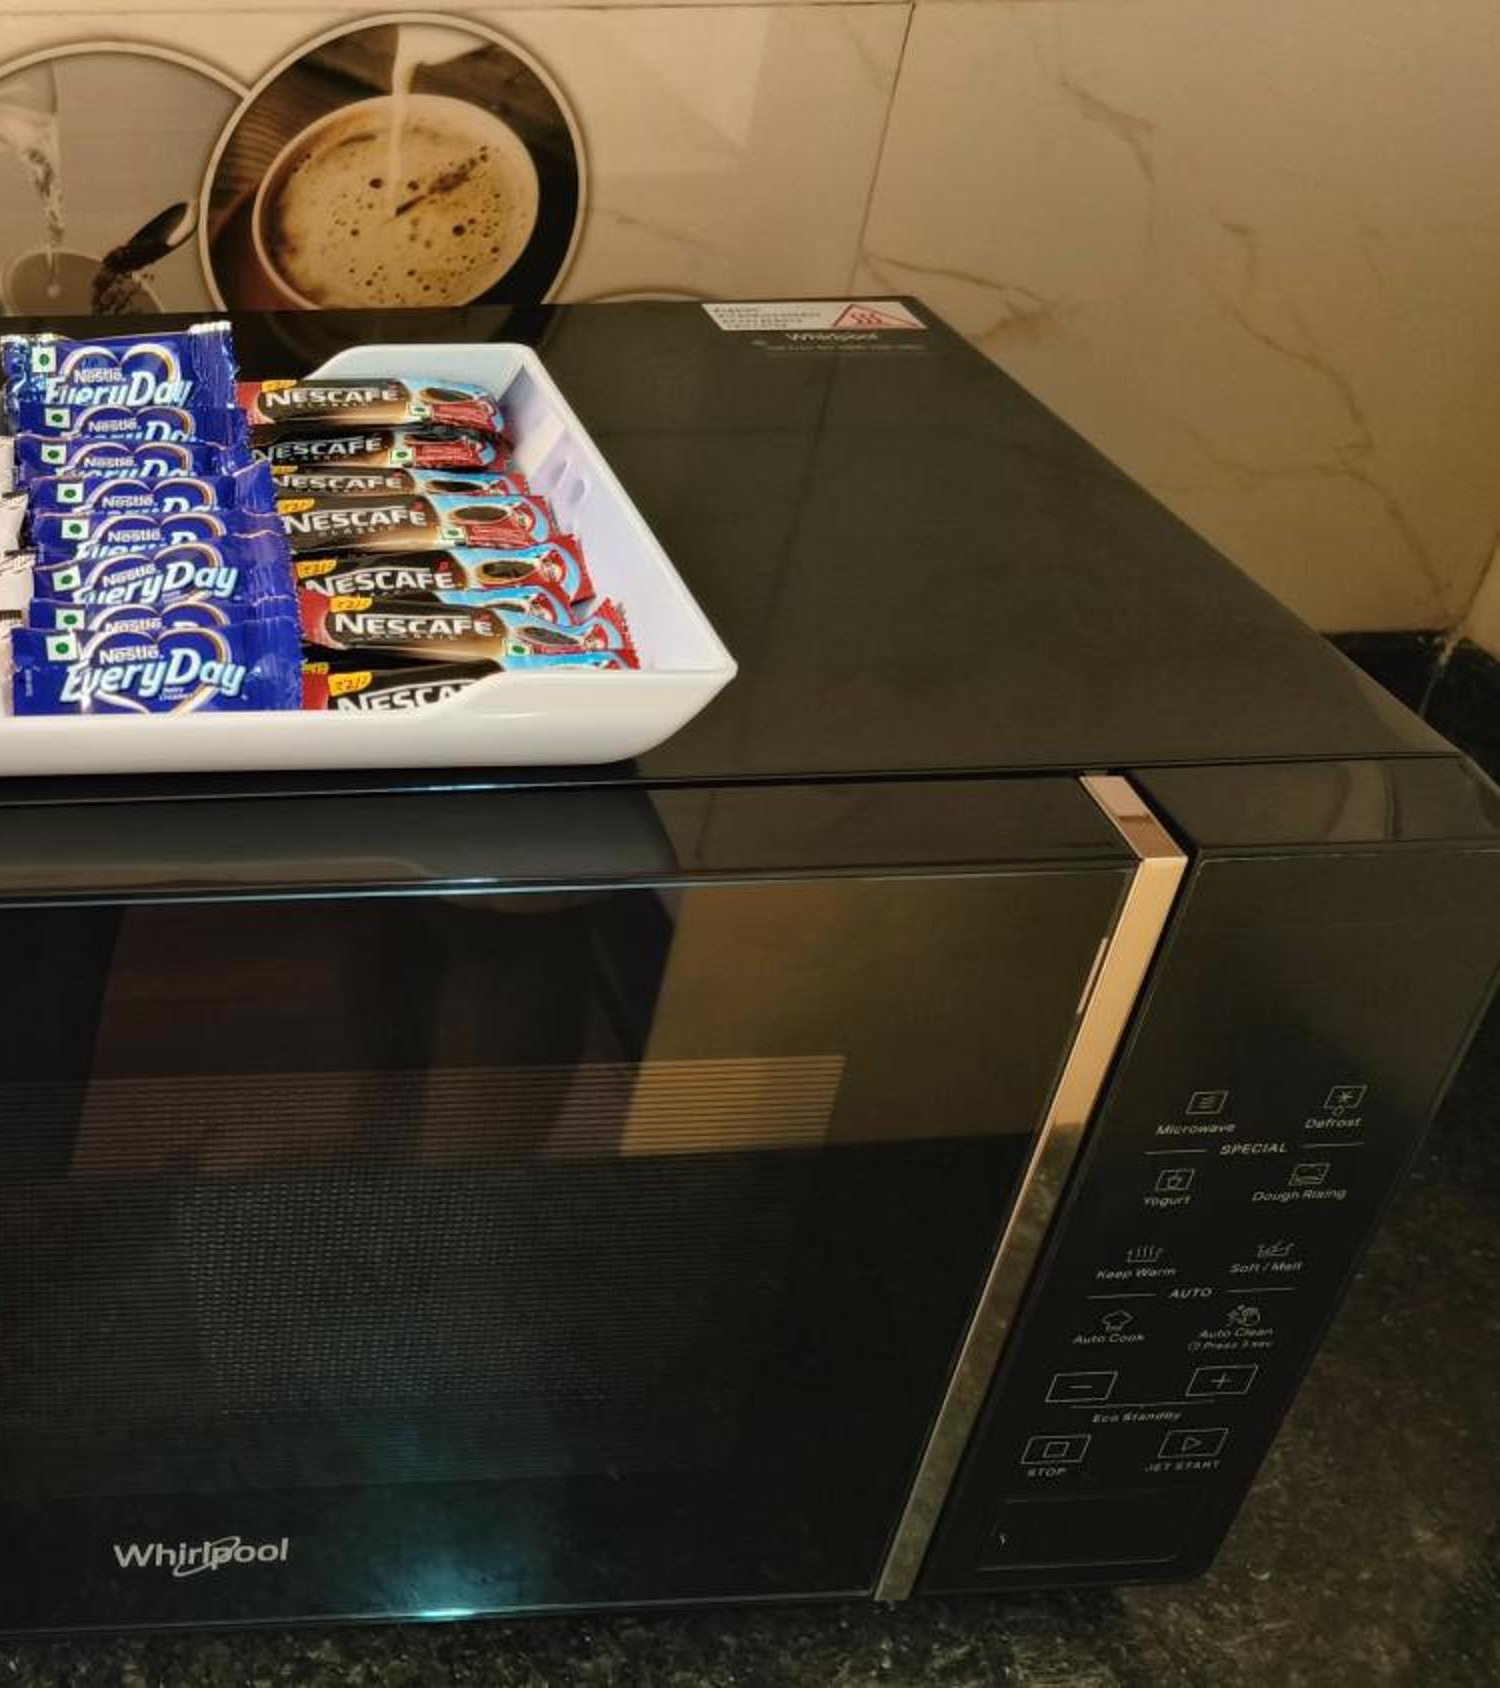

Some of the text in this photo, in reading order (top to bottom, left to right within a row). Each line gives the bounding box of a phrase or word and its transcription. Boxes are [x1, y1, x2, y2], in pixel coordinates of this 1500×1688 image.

[60, 649, 247, 702] EveryDay
[335, 682, 461, 711] NESCA
[1156, 1122, 1236, 1137] Microwave
[1304, 1117, 1363, 1130] Defrost
[1219, 1142, 1288, 1155] SPECIAL
[1144, 1195, 1190, 1208] Yogurt
[1252, 1189, 1299, 1203] Dough
[1136, 1266, 1176, 1278] Warm
[1168, 1288, 1213, 1300] AUTO
[1072, 1333, 1106, 1345] Auto
[1200, 1328, 1231, 1339] Auto
[1027, 1466, 1067, 1478] STOP
[113, 1536, 289, 1573] Whirlpool
